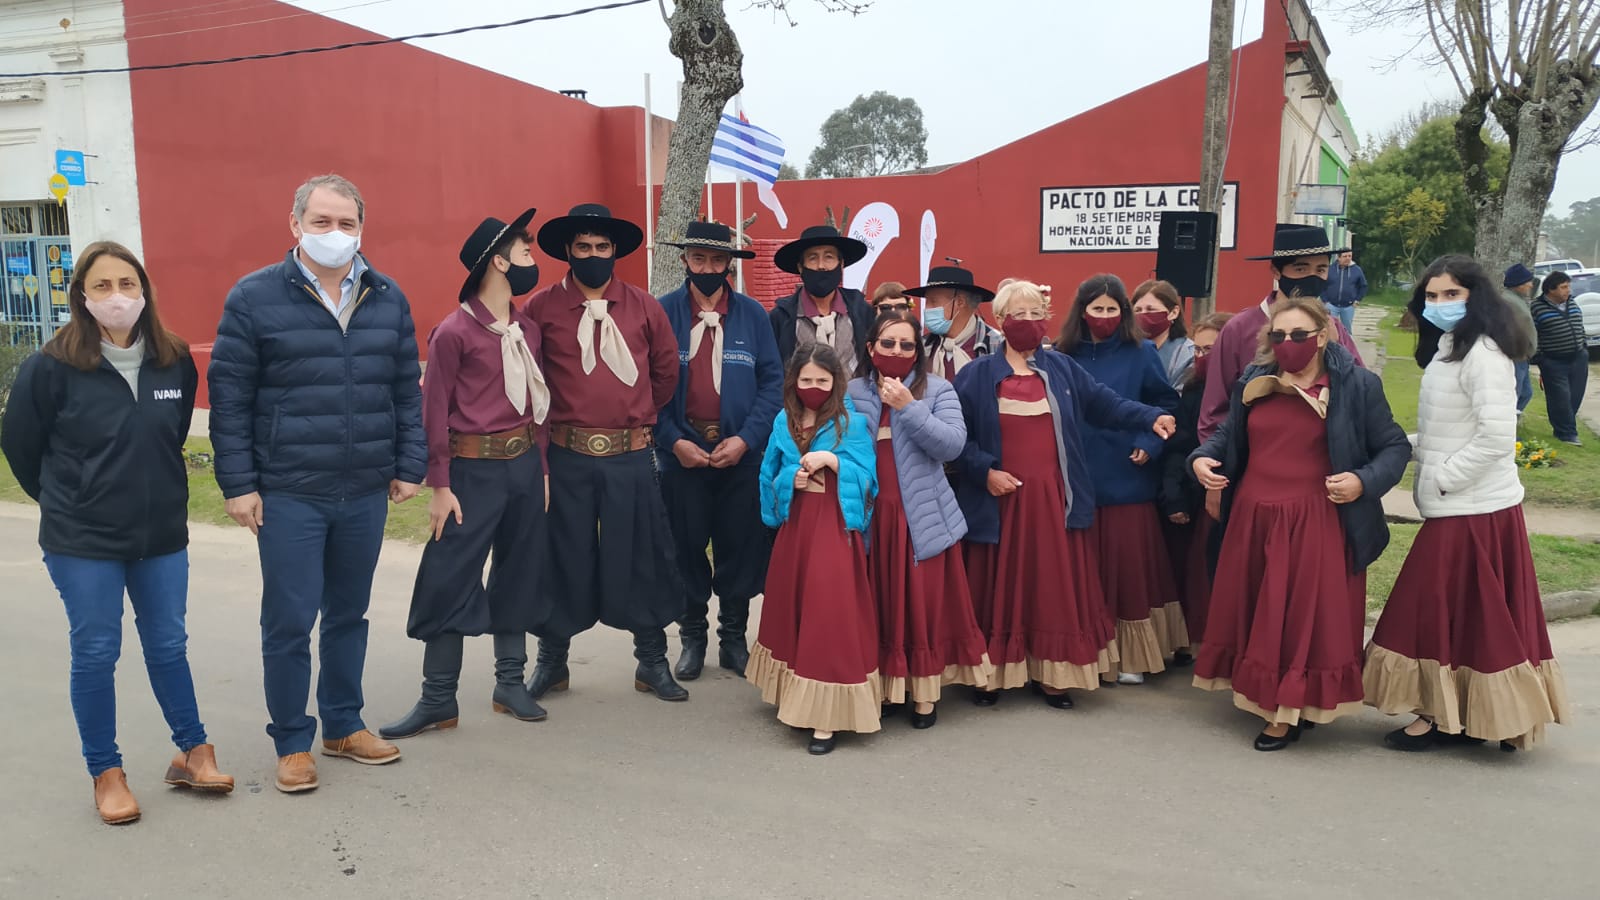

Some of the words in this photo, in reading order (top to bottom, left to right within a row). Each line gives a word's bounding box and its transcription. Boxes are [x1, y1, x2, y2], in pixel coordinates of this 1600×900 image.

[1050, 191, 1106, 210] PACTO
[1114, 190, 1137, 208] DE
[1145, 190, 1168, 207] LA
[1177, 189, 1227, 206] CR
[1076, 213, 1087, 223] 18
[1092, 211, 1161, 223] SETIEMBRE
[1049, 225, 1112, 236] HOMENAJE
[1117, 225, 1132, 235] DE
[1137, 225, 1152, 234] LA
[1069, 236, 1130, 246] NACIONAL
[1136, 236, 1152, 246] DE
[153, 388, 182, 400] IVANA
